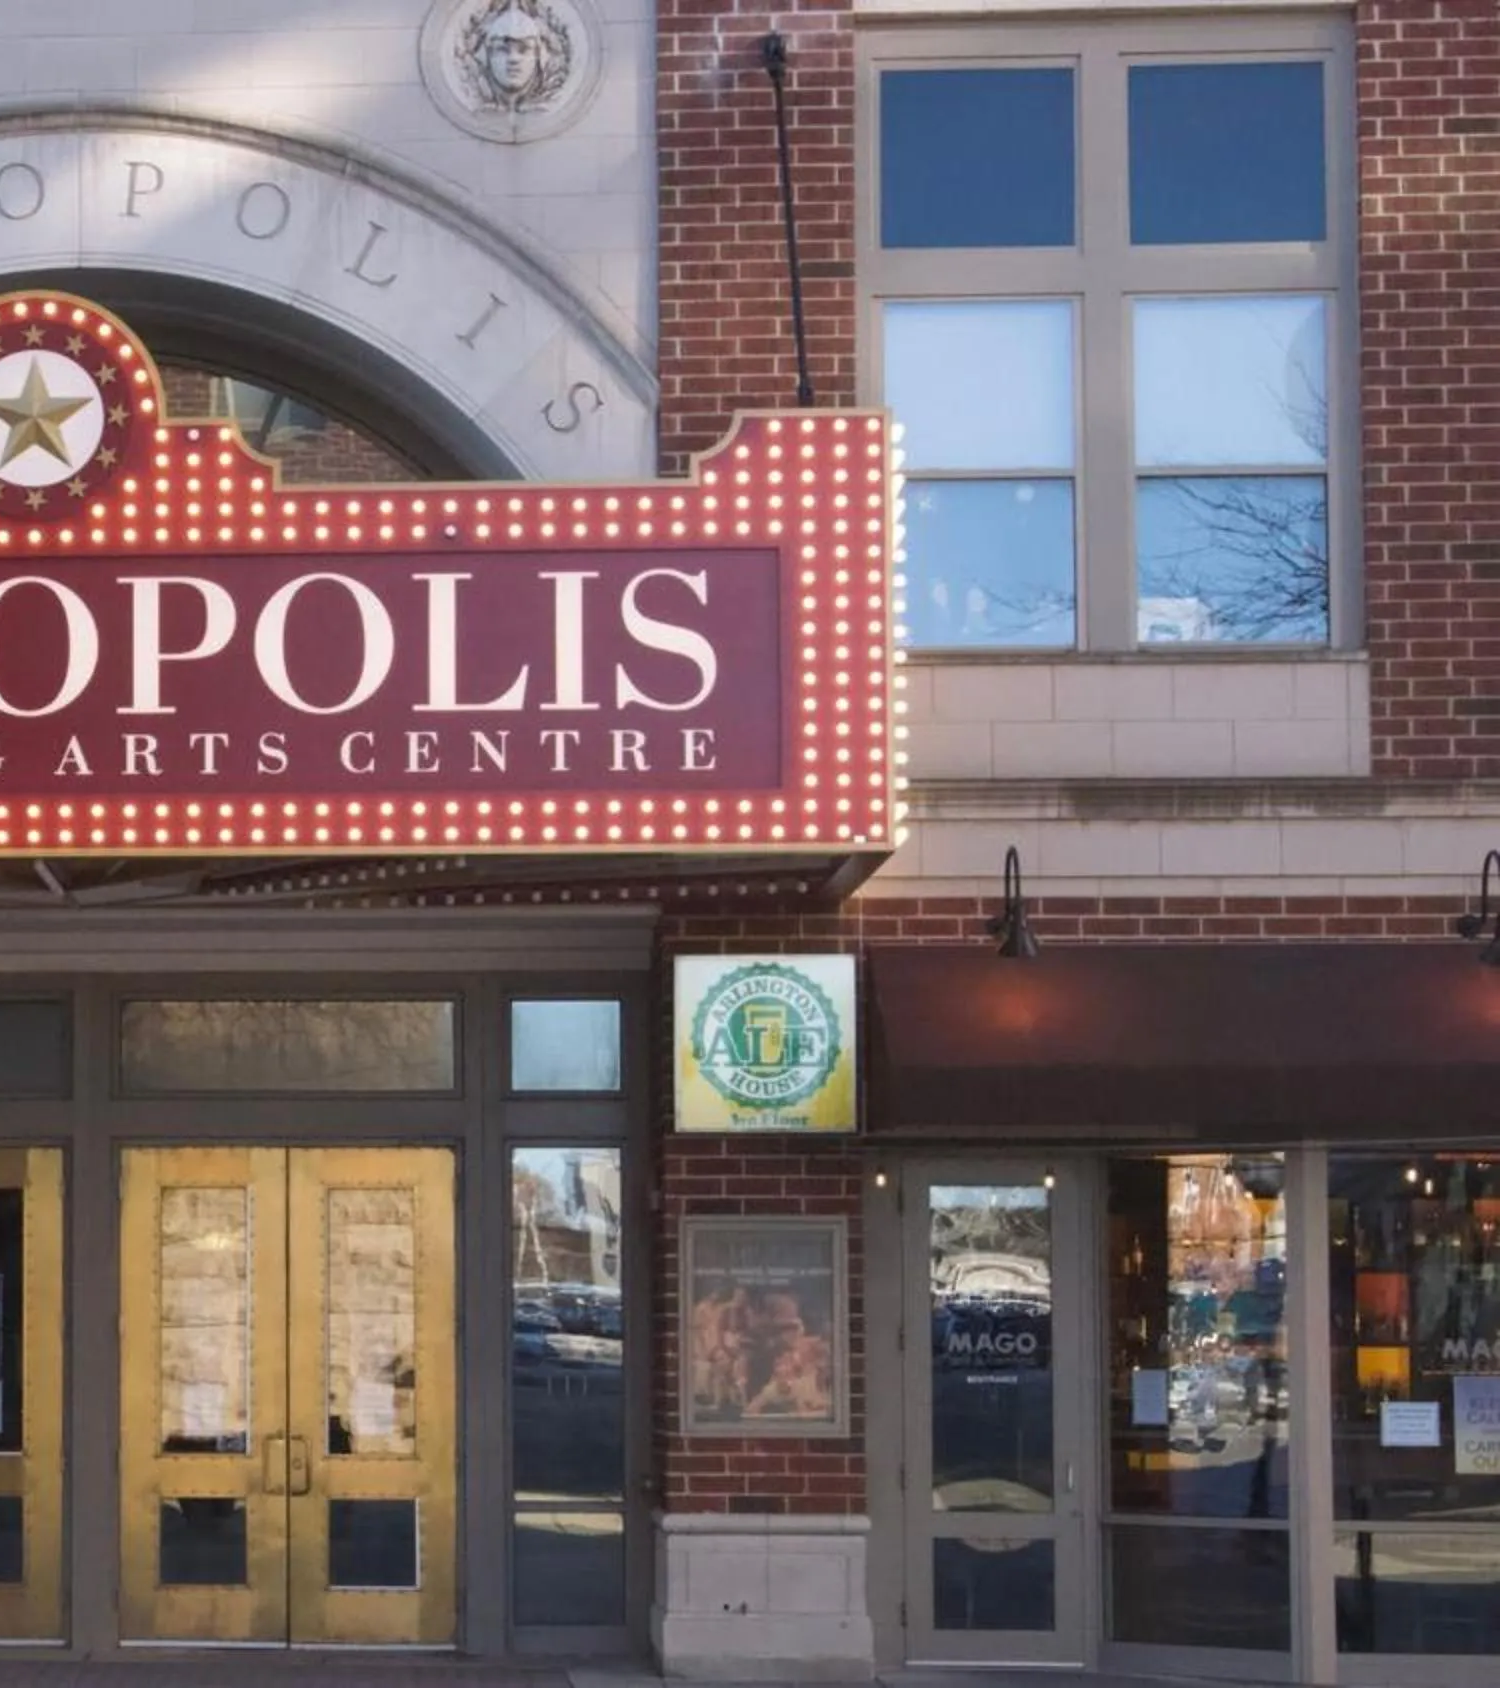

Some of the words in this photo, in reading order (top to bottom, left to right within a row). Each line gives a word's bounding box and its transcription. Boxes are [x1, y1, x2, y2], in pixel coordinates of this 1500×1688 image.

[53, 732, 290, 777] ARTS
[339, 728, 718, 774] CENTRE
[712, 978, 822, 1025] ARLINGTON
[702, 1027, 827, 1067] ALE
[728, 1071, 805, 1098] HOUSE
[947, 1331, 1039, 1355] MAGO
